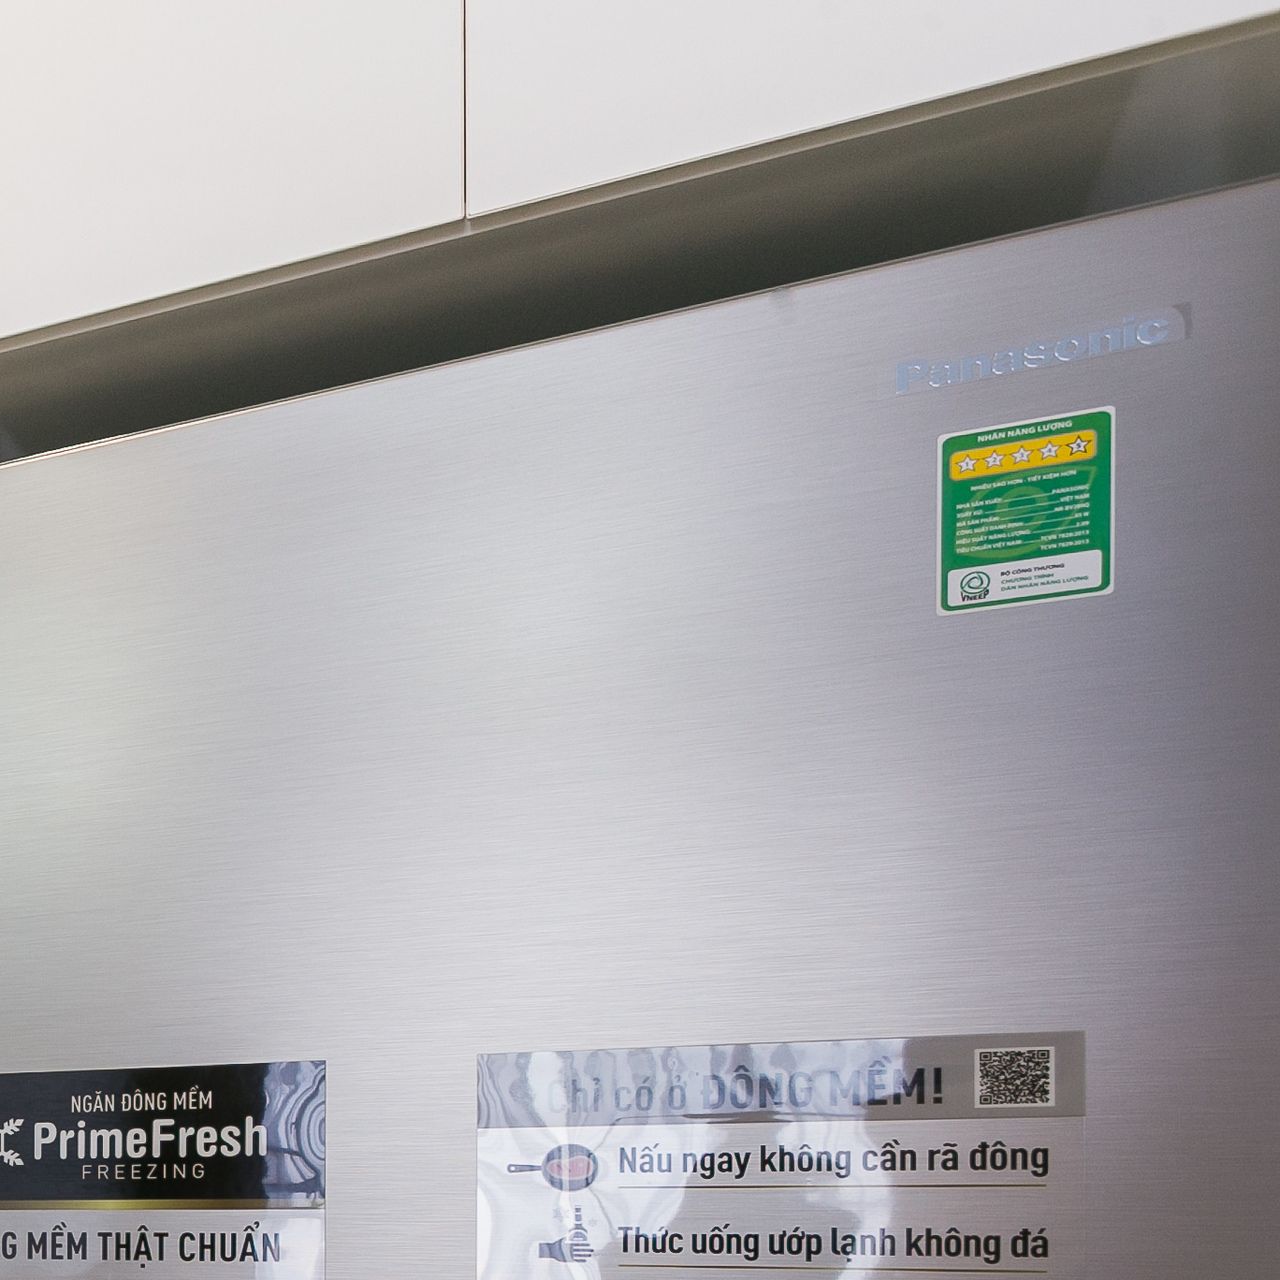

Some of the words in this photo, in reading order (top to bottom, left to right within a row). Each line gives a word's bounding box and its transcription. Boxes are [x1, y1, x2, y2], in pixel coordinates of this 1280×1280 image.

[895, 316, 1170, 394] Panasonic
[71, 1090, 116, 1114] NGĂN
[120, 1088, 169, 1112] ĐÔNG
[173, 1085, 213, 1111] MỀM
[615, 1077, 653, 1112] có
[667, 1075, 687, 1111] ở
[701, 1059, 814, 1111] ĐÔNG
[828, 1053, 944, 1108] MỀM!
[33, 1115, 268, 1161] PrimeFresh
[618, 1141, 672, 1176] Nấu
[681, 1152, 749, 1180] ngay
[759, 1144, 852, 1178] không
[861, 1137, 923, 1173] cần
[926, 1145, 959, 1172] rã
[969, 1143, 1050, 1177] đông
[81, 1163, 206, 1180] FREEZING
[26, 1220, 88, 1261] MỀM
[98, 1223, 169, 1268] THẬT
[178, 1220, 281, 1262] CHUẨN
[618, 1222, 683, 1255] Thức
[690, 1222, 761, 1260] uống
[767, 1226, 823, 1263] ướp
[830, 1227, 896, 1263] lạnh
[904, 1229, 1001, 1264] không
[1010, 1228, 1050, 1259] đá
